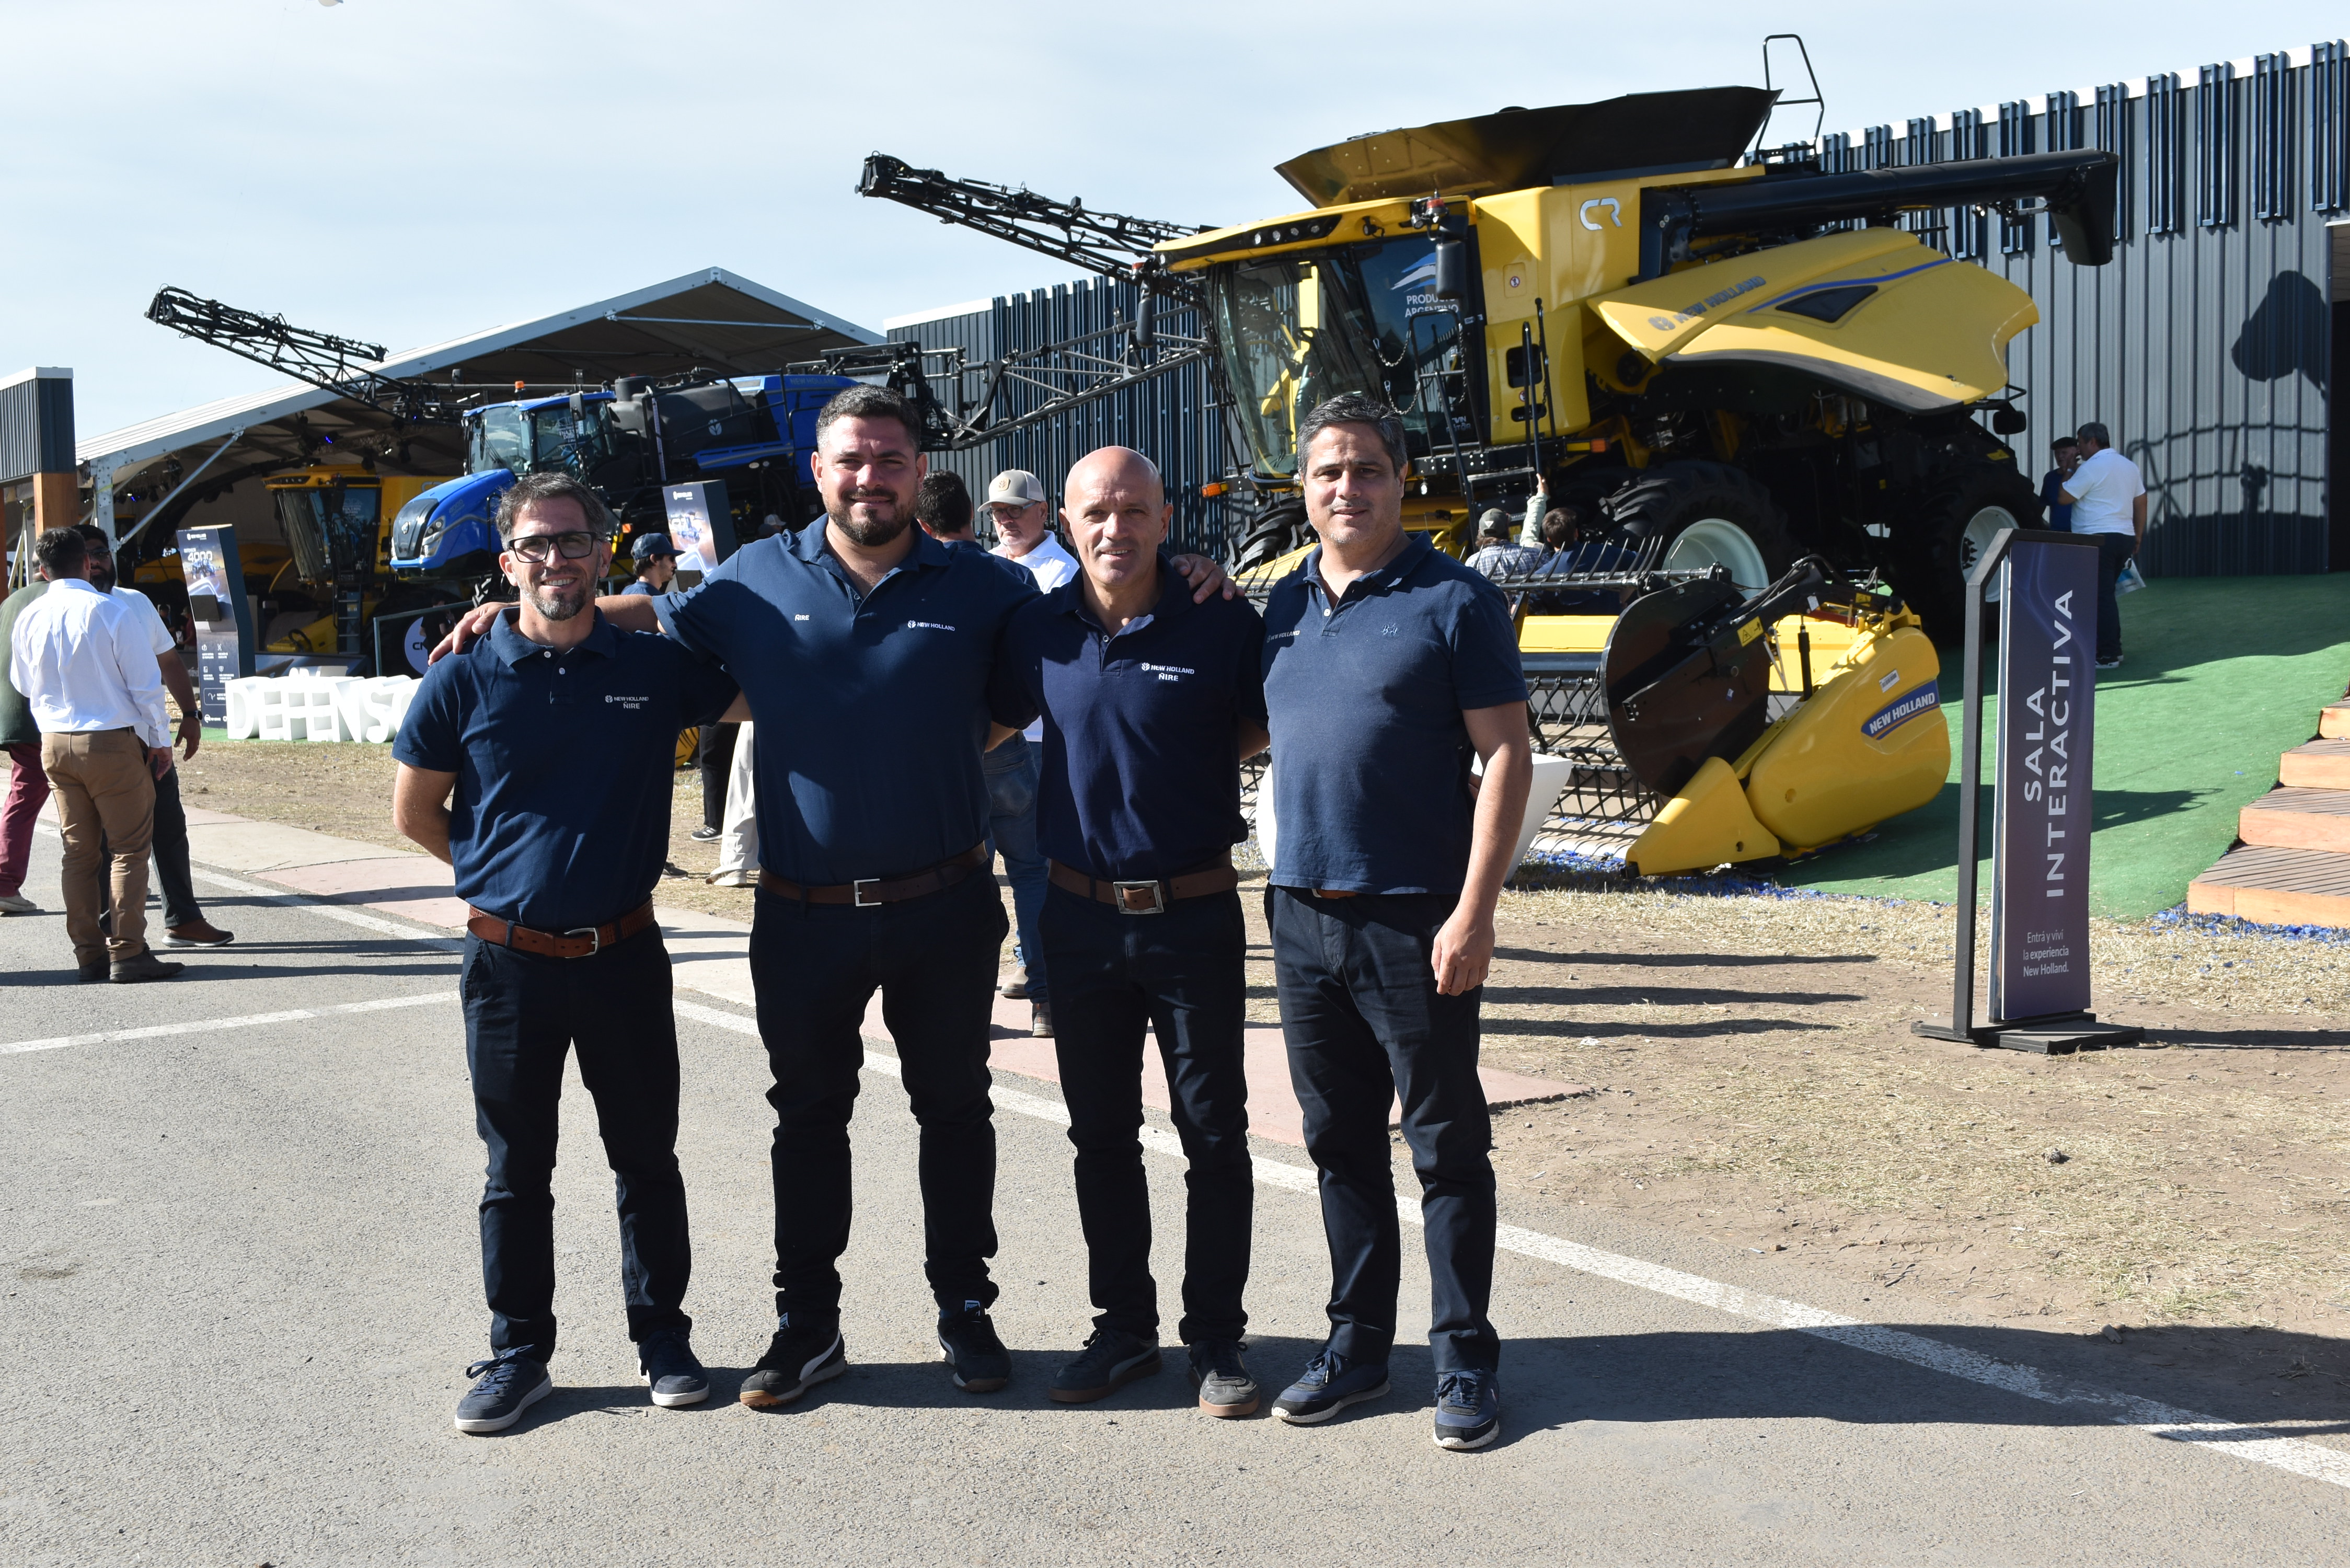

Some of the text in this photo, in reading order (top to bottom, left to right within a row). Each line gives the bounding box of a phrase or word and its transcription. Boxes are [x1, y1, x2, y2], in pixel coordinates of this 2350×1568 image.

[1580, 197, 1622, 230] CR
[1407, 294, 1456, 305] PRODU
[1673, 276, 1767, 324] NEW HOLLAND
[930, 623, 955, 631] HOLLAND
[1158, 672, 1179, 681] ÑIRE
[1166, 666, 1194, 674] HOLLAND
[1869, 693, 1936, 734] NEW HOLLAND
[2024, 687, 2045, 802] SALA
[2046, 590, 2073, 897] INTERACTIVA
[2028, 929, 2064, 943] Entrá y viví
[2023, 945, 2069, 961] la experiencia
[2023, 961, 2069, 977] New Holland.
